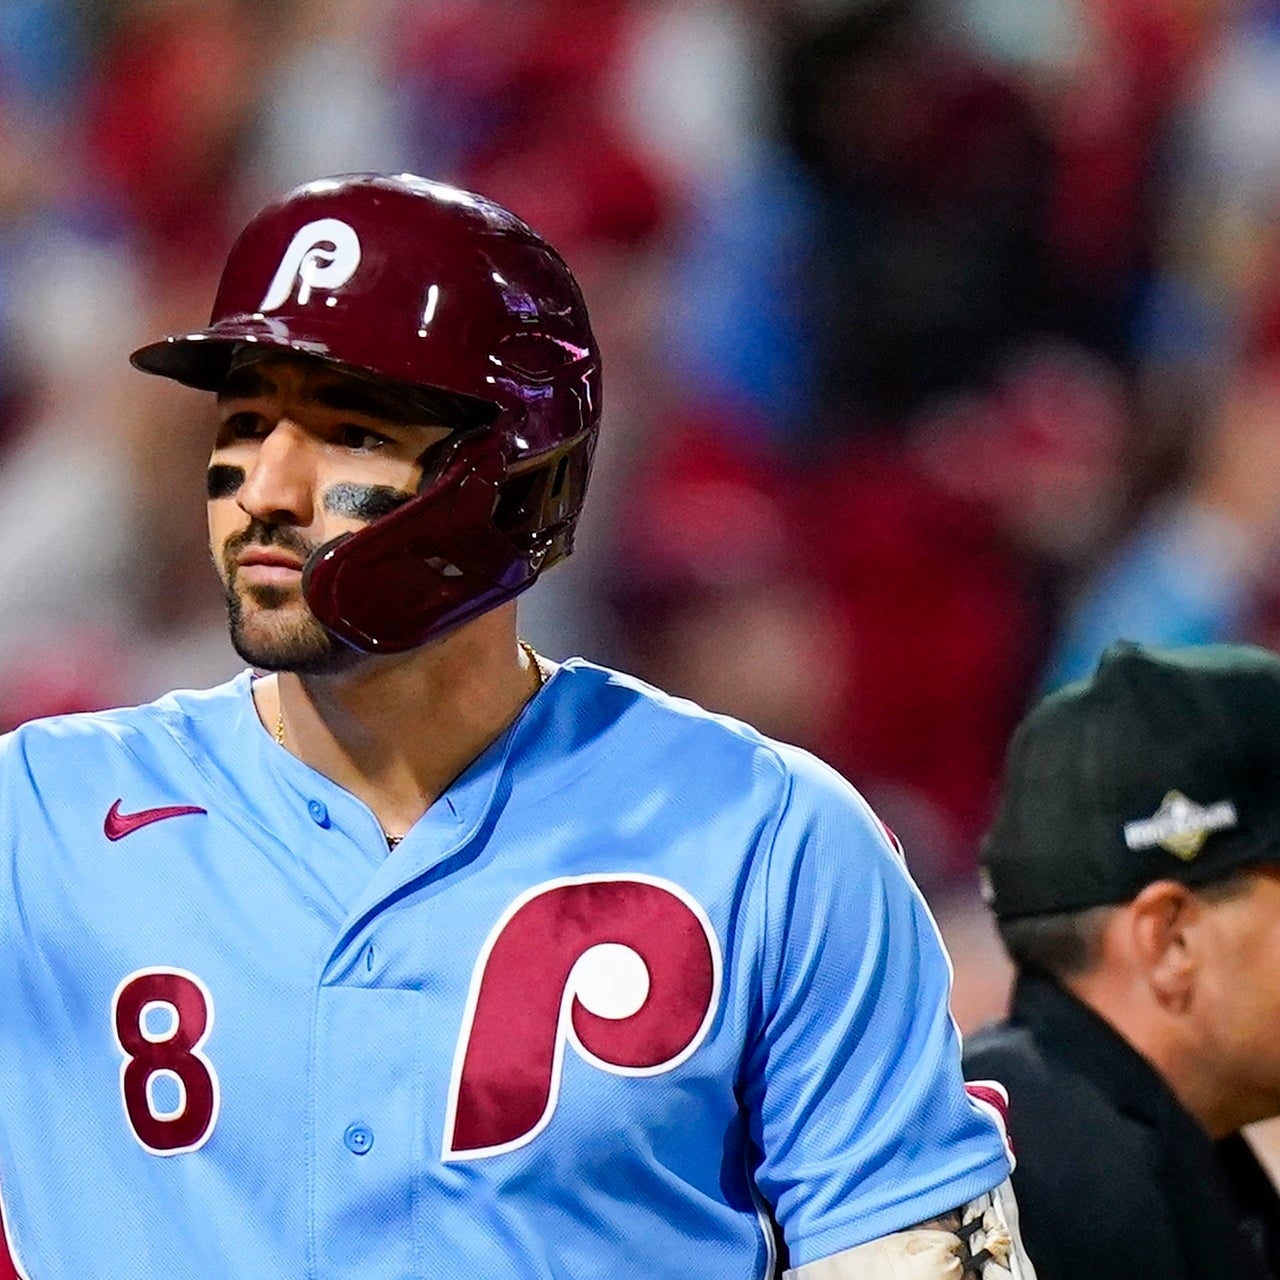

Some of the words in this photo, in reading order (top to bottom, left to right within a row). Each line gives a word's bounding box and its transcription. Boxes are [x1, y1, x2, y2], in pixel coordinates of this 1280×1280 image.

[260, 218, 361, 312] P
[111, 966, 221, 1158] 8
[441, 873, 724, 1162] P
